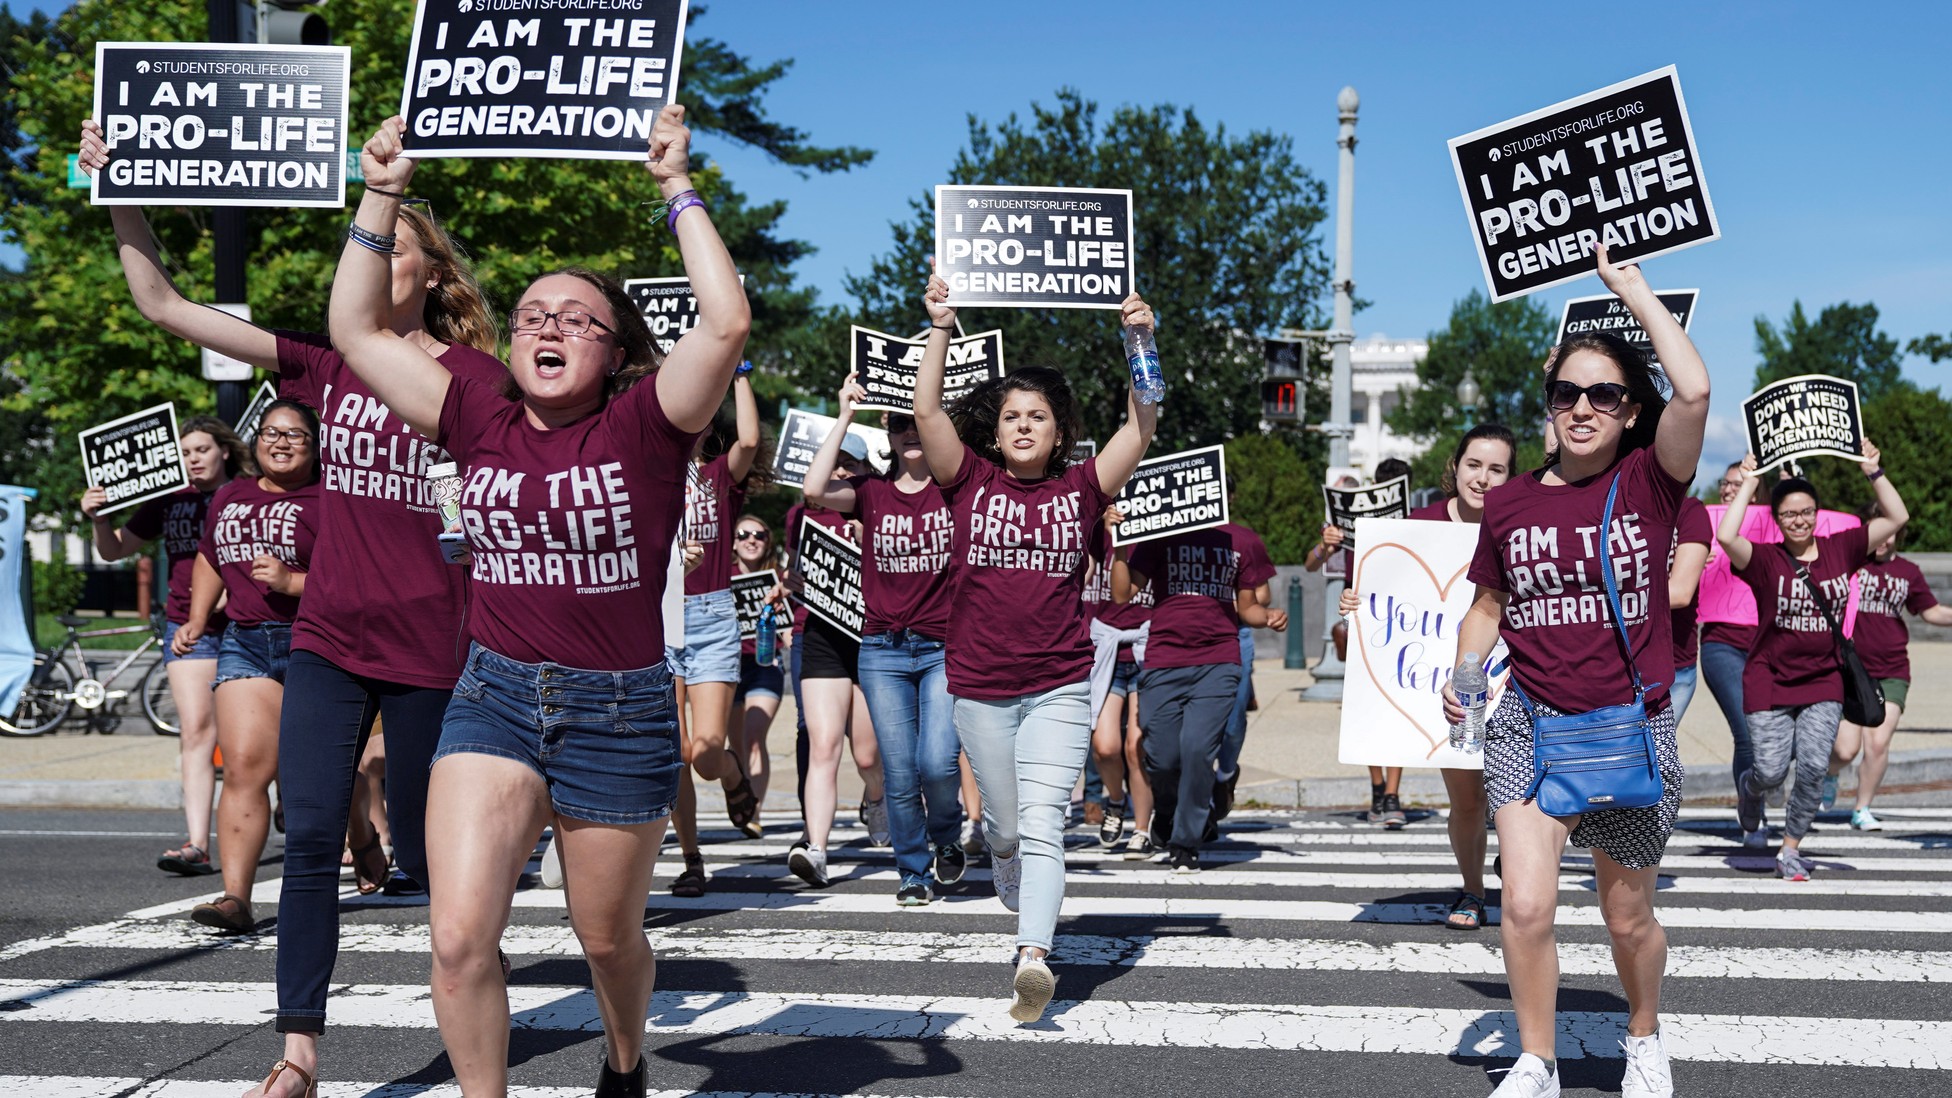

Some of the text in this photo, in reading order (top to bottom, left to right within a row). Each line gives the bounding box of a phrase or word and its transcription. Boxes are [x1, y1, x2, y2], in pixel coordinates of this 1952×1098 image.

[476, 0, 643, 11] STUDENTSFORLIFE.ORG
[436, 18, 656, 50] I AM THE
[153, 61, 309, 76] STUDENTSFORLIFE.ORG
[416, 55, 667, 98] PRO-LIFE
[119, 81, 323, 109] I AM THE
[106, 114, 335, 152] PRO-LIFE
[414, 105, 654, 139] GENERATION
[1502, 101, 1644, 157] STUDENTSFORLIFE.ORG
[109, 159, 328, 189] GENERATION
[1480, 118, 1667, 200] I AM THE
[981, 199, 1101, 211] STUDENTSFORLIFE.ORG
[1480, 149, 1693, 246] PRO-LIFE
[956, 214, 1114, 236] I AM THE
[1499, 198, 1698, 280] GENERATION
[946, 239, 1125, 268] PRO-LIFE
[649, 288, 692, 296] STUDENTSFO
[950, 272, 1121, 295] GENERATION
[645, 298, 679, 313] AM
[1607, 302, 1620, 314] Yo
[643, 314, 700, 335] RO-LI
[1567, 312, 1684, 333] GENERAN
[866, 336, 987, 368] I AM
[1789, 382, 1807, 394] WE
[322, 384, 390, 431] I AM
[1754, 392, 1848, 426] DON'T NEED
[1757, 407, 1852, 444] PLANNED
[1760, 425, 1854, 457] PARENTHOOD
[91, 426, 169, 464] I AM THE
[320, 422, 454, 476] PRO-LIF
[90, 442, 178, 487] PRO-LIFE
[1134, 458, 1206, 479] STUDENTSFORLIFE.ORG
[1134, 476, 1166, 494] AM
[1174, 466, 1213, 486] THE
[104, 465, 180, 502] ENERATION
[321, 463, 437, 505] ENERATIO
[462, 466, 526, 508] AM
[545, 462, 630, 508] THE
[1116, 480, 1221, 516] PRO-LIFE
[1331, 483, 1402, 512] I AM
[220, 503, 254, 520] AM
[972, 486, 1080, 527] I AM THE
[1119, 502, 1220, 536] GENERATION
[214, 519, 296, 546] RO-LIFE
[461, 504, 635, 550] RO-LIFE
[882, 514, 912, 535] AM
[970, 512, 1083, 550] PRO-LIFE
[1508, 526, 1559, 564] AM
[1576, 512, 1648, 558] THE
[804, 540, 810, 554] I
[813, 548, 836, 570] AM
[873, 528, 955, 556] PRO-LIF
[1178, 546, 1206, 564] AM
[1212, 547, 1241, 568] THE
[874, 552, 952, 574] GENERATIO
[1506, 550, 1650, 600] PRO-LFE
[576, 581, 640, 594] STUDENTSFORLIFE.ORG
[1778, 575, 1784, 596] I
[804, 583, 863, 632] ENERATION
[1370, 593, 1446, 648] You
[1506, 588, 1650, 630] GENERATON
[1775, 615, 1832, 632] GENERA
